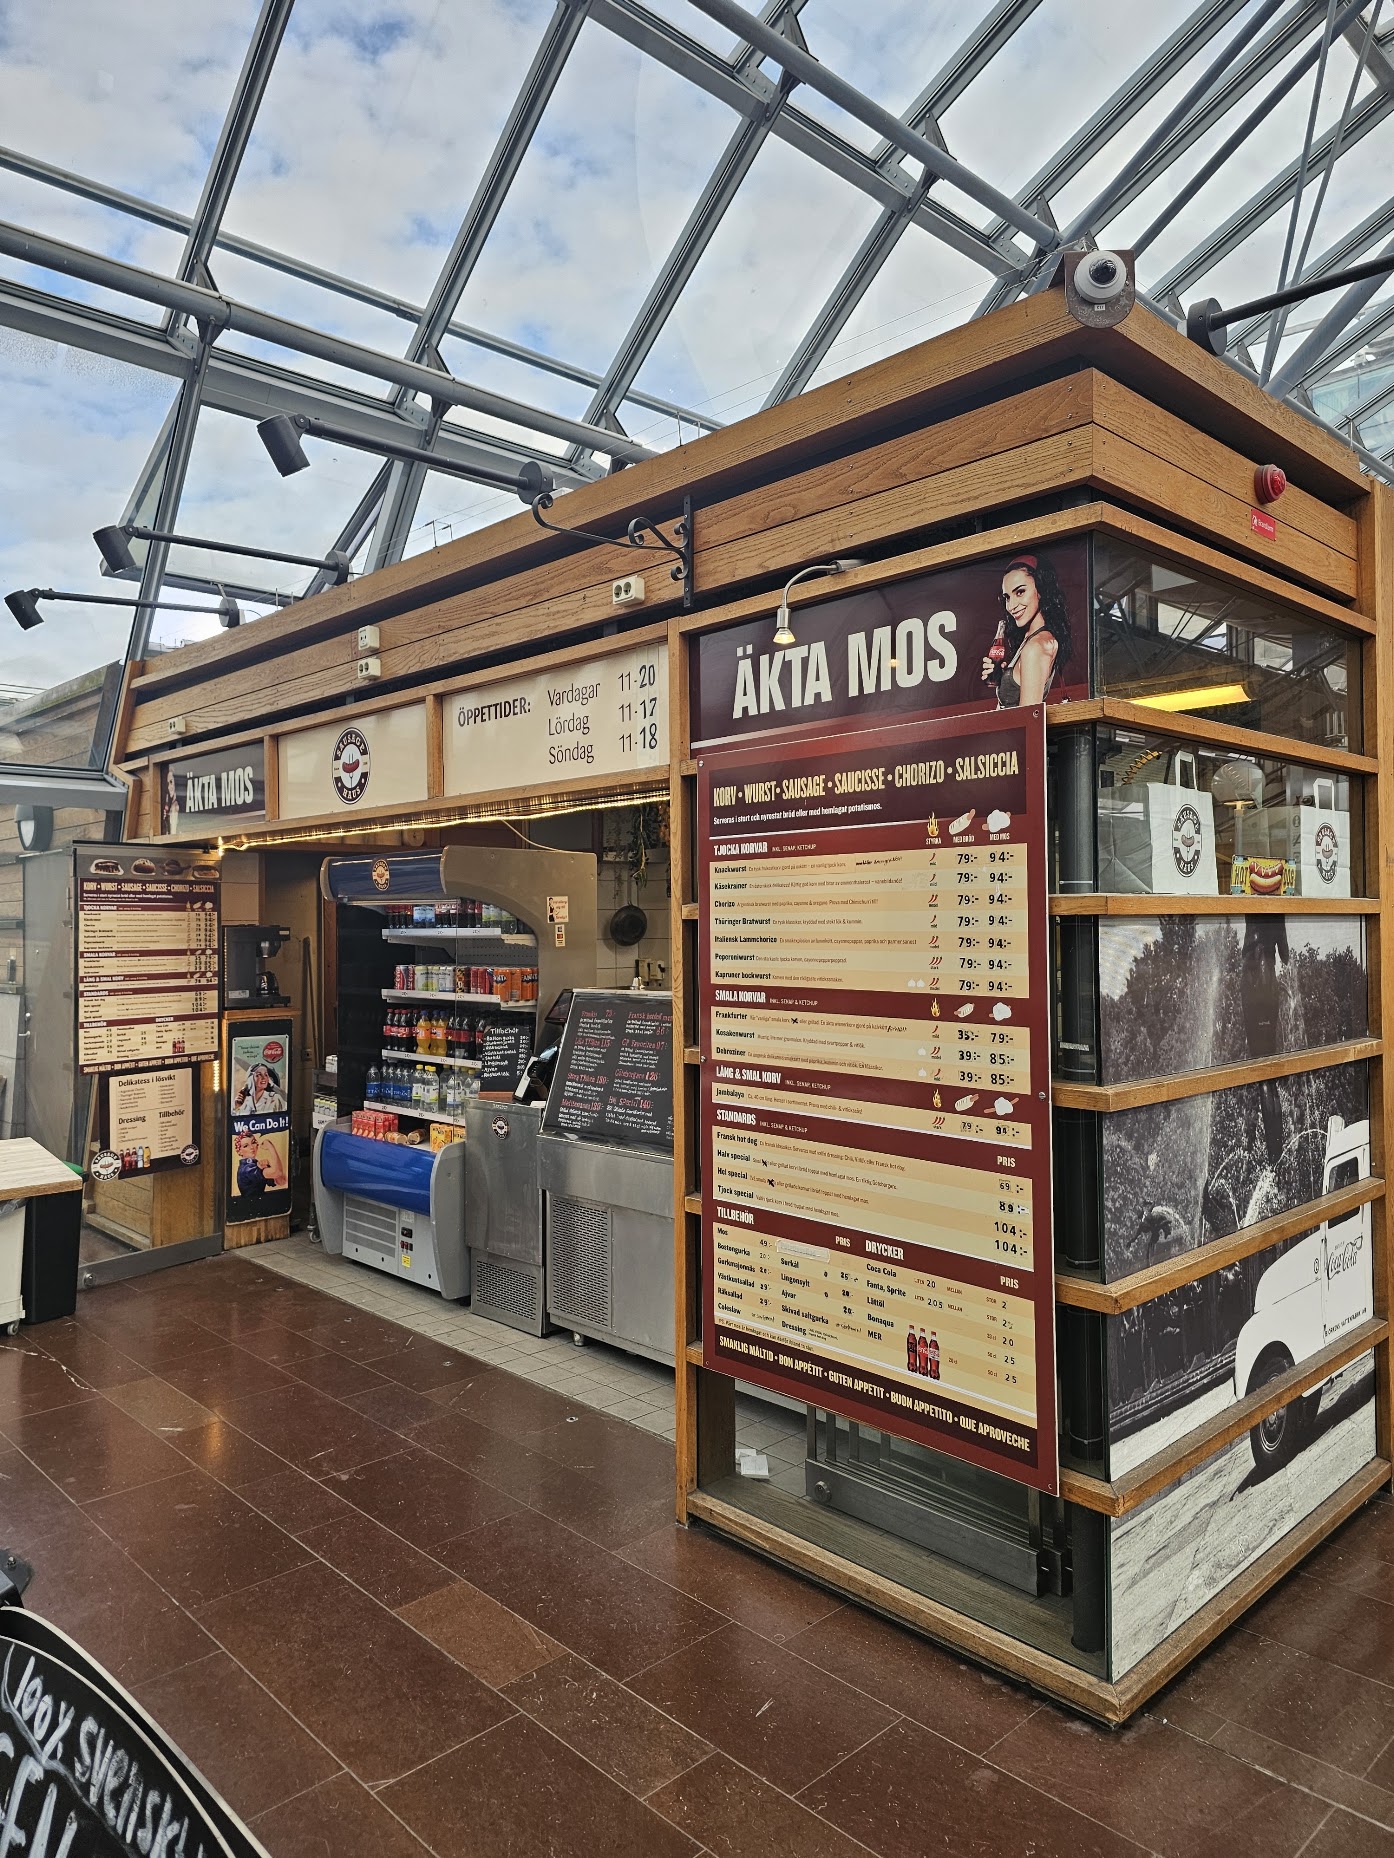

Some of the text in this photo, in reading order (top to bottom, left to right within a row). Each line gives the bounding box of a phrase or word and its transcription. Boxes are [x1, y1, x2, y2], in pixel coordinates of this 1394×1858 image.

[732, 610, 957, 719] ÄKTA MOS
[547, 682, 600, 707] Vardagar
[458, 697, 531, 727] ÖPPETTIDER:
[549, 713, 590, 735] Lördag
[337, 734, 365, 757] SAUSAGE
[549, 741, 594, 764] Söndag
[714, 751, 1018, 807] KORV WURST SAUSAGE SAUCISSE CHORIZO SALSICCIA
[186, 766, 254, 812] ÄKTA MOS
[343, 787, 360, 799] HAUS
[714, 816, 734, 824] Serveras
[738, 814, 750, 822] stort
[751, 813, 760, 821] och
[761, 812, 782, 822] nyrostat
[783, 809, 795, 818] bröd
[796, 808, 807, 817] eller
[809, 808, 820, 816] med
[822, 805, 847, 816] hemlagat
[848, 803, 882, 813] potatismos.
[714, 844, 739, 856] TJOCKA
[741, 842, 768, 853] KORVAR
[715, 918, 741, 926] Thüringer
[715, 971, 741, 980] Kapruner
[742, 972, 771, 980] bockwurst
[716, 990, 738, 1001] SMALA
[739, 991, 766, 1003] KORVAR
[716, 1011, 747, 1020] Frankfurter
[118, 1078, 150, 1087] Delikatess
[155, 1074, 176, 1082] lösvikt
[716, 1065, 733, 1079] LÅNG
[735, 1069, 740, 1079] &
[742, 1069, 761, 1082] SMAL
[762, 1071, 781, 1084] KORV
[812, 1082, 831, 1090] KETCHUP
[716, 1088, 744, 1099] Jambalaya
[118, 1116, 146, 1125] Dressing
[159, 1109, 185, 1118] Tillbehör
[717, 1109, 756, 1125] STANDARDS
[234, 1117, 289, 1132] We Can Do It!
[717, 1132, 758, 1146] Fransk hot dog
[717, 1150, 750, 1162] Halv special
[997, 1156, 1016, 1168] PRIS
[728, 1169, 748, 1180] special
[718, 1185, 754, 1199] Tjock special
[717, 1206, 754, 1225] TILLBEHÖR
[717, 1228, 728, 1236] Mos
[835, 1236, 850, 1247] PRIS
[717, 1243, 750, 1256] Bostongurka
[866, 1240, 904, 1260] DRYCKER
[781, 1258, 799, 1268] Surkål
[866, 1263, 881, 1274] Coca
[883, 1266, 897, 1277] Cola
[718, 1272, 755, 1288] Västkustsallad
[781, 1274, 810, 1287] Lingonsylt
[1000, 1276, 1019, 1288] PRIS
[718, 1287, 742, 1300] Räksallad
[782, 1290, 796, 1300] Ajvar
[867, 1280, 886, 1293] Fanta,
[887, 1284, 906, 1297] Sprite
[718, 1303, 741, 1315] Coleslaw
[867, 1297, 885, 1308] Lättöl
[782, 1305, 800, 1317] Skivad
[802, 1311, 829, 1326] saltgurka
[782, 1321, 807, 1336] Dressing
[867, 1313, 895, 1328] Bonaqua
[1004, 1356, 1015, 1365] 25
[868, 1330, 1017, 1384] MER 25
[719, 1335, 748, 1353] SMAKLIG
[750, 1344, 774, 1361] MÅLTID
[779, 1354, 793, 1368] BON
[795, 1361, 823, 1378] APPÉTIT
[829, 1371, 852, 1388] GUTEN
[854, 1377, 884, 1399] APPETIT
[891, 1391, 913, 1411] BUON
[914, 1398, 953, 1423] APPETITO
[959, 1416, 977, 1434] QUE
[978, 1422, 1030, 1452] APROVECHE
